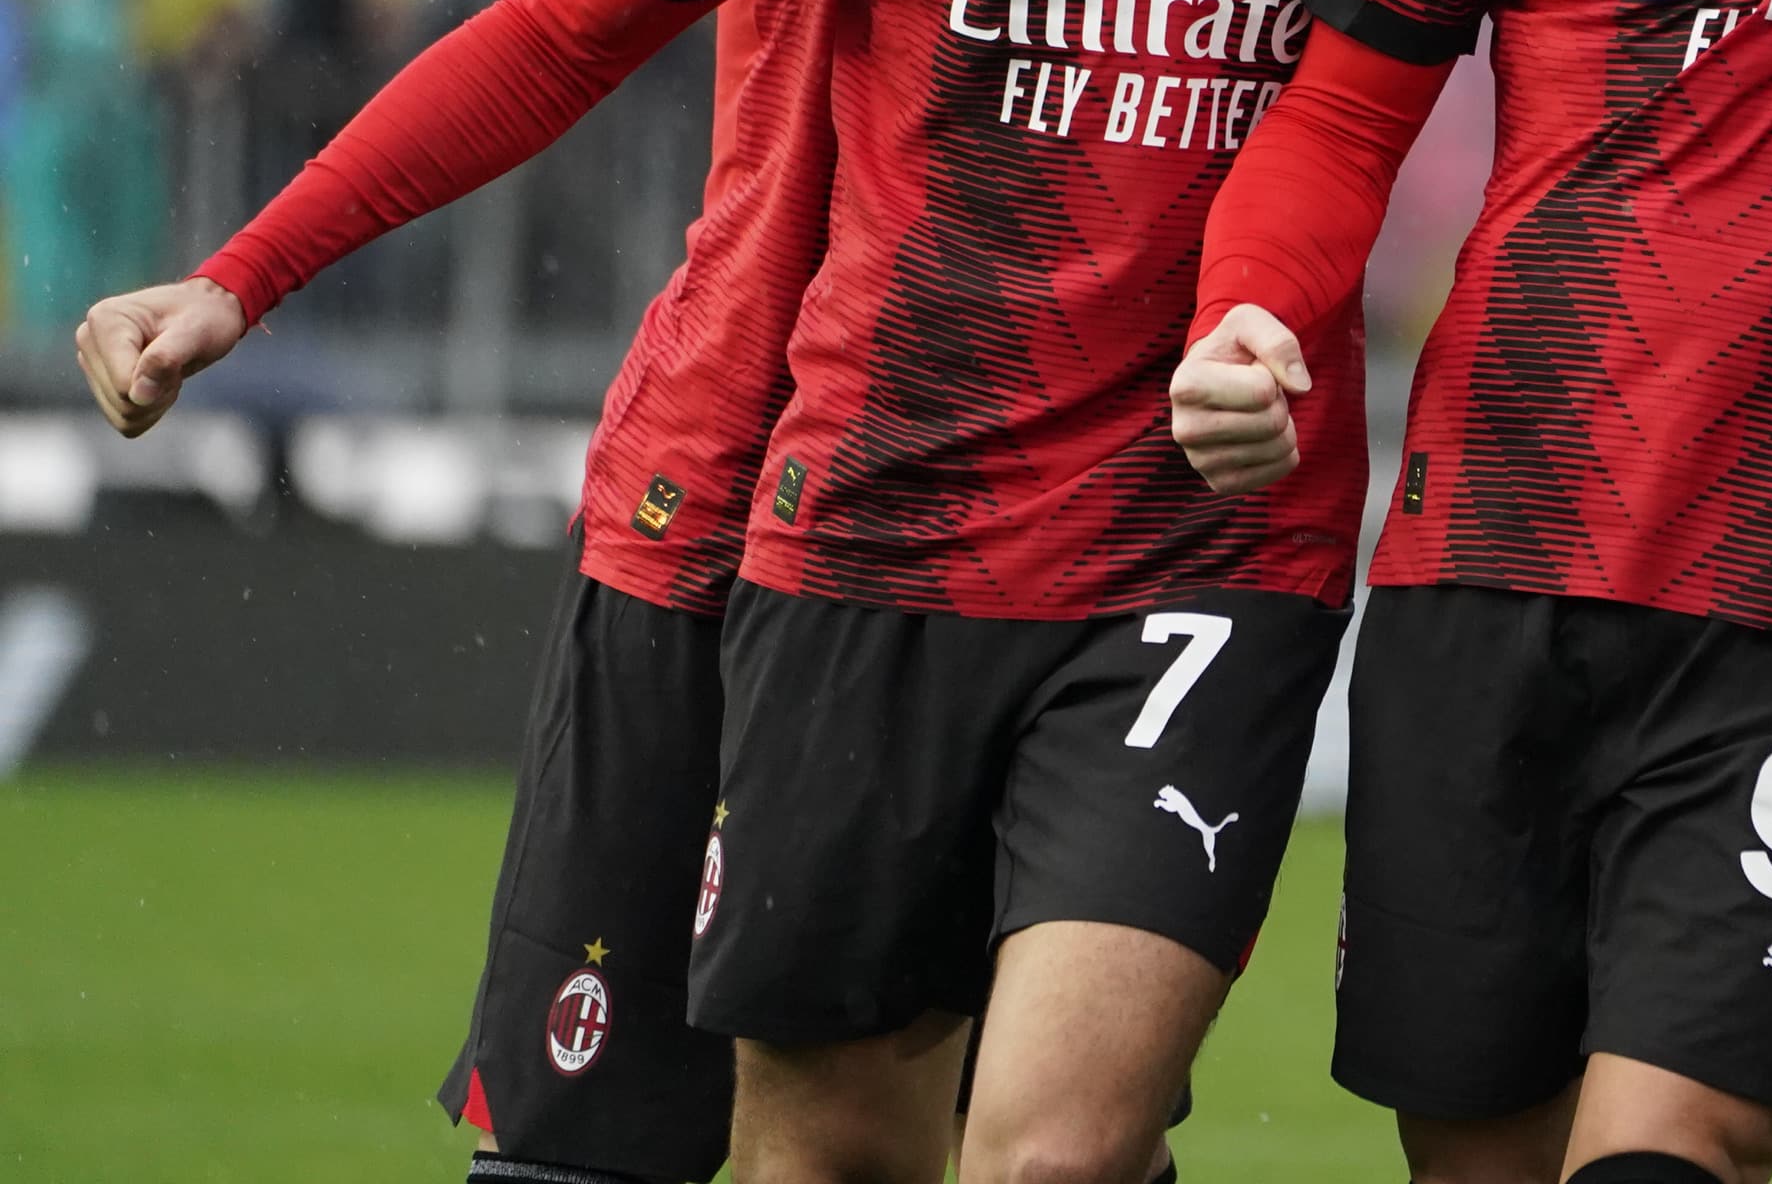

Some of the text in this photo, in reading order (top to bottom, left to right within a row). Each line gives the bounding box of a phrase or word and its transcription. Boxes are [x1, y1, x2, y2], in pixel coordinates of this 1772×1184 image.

[1000, 58, 1093, 137] FLY
[1124, 612, 1233, 748] 7
[568, 977, 603, 1002] ACM
[556, 1049, 586, 1064] 1899
